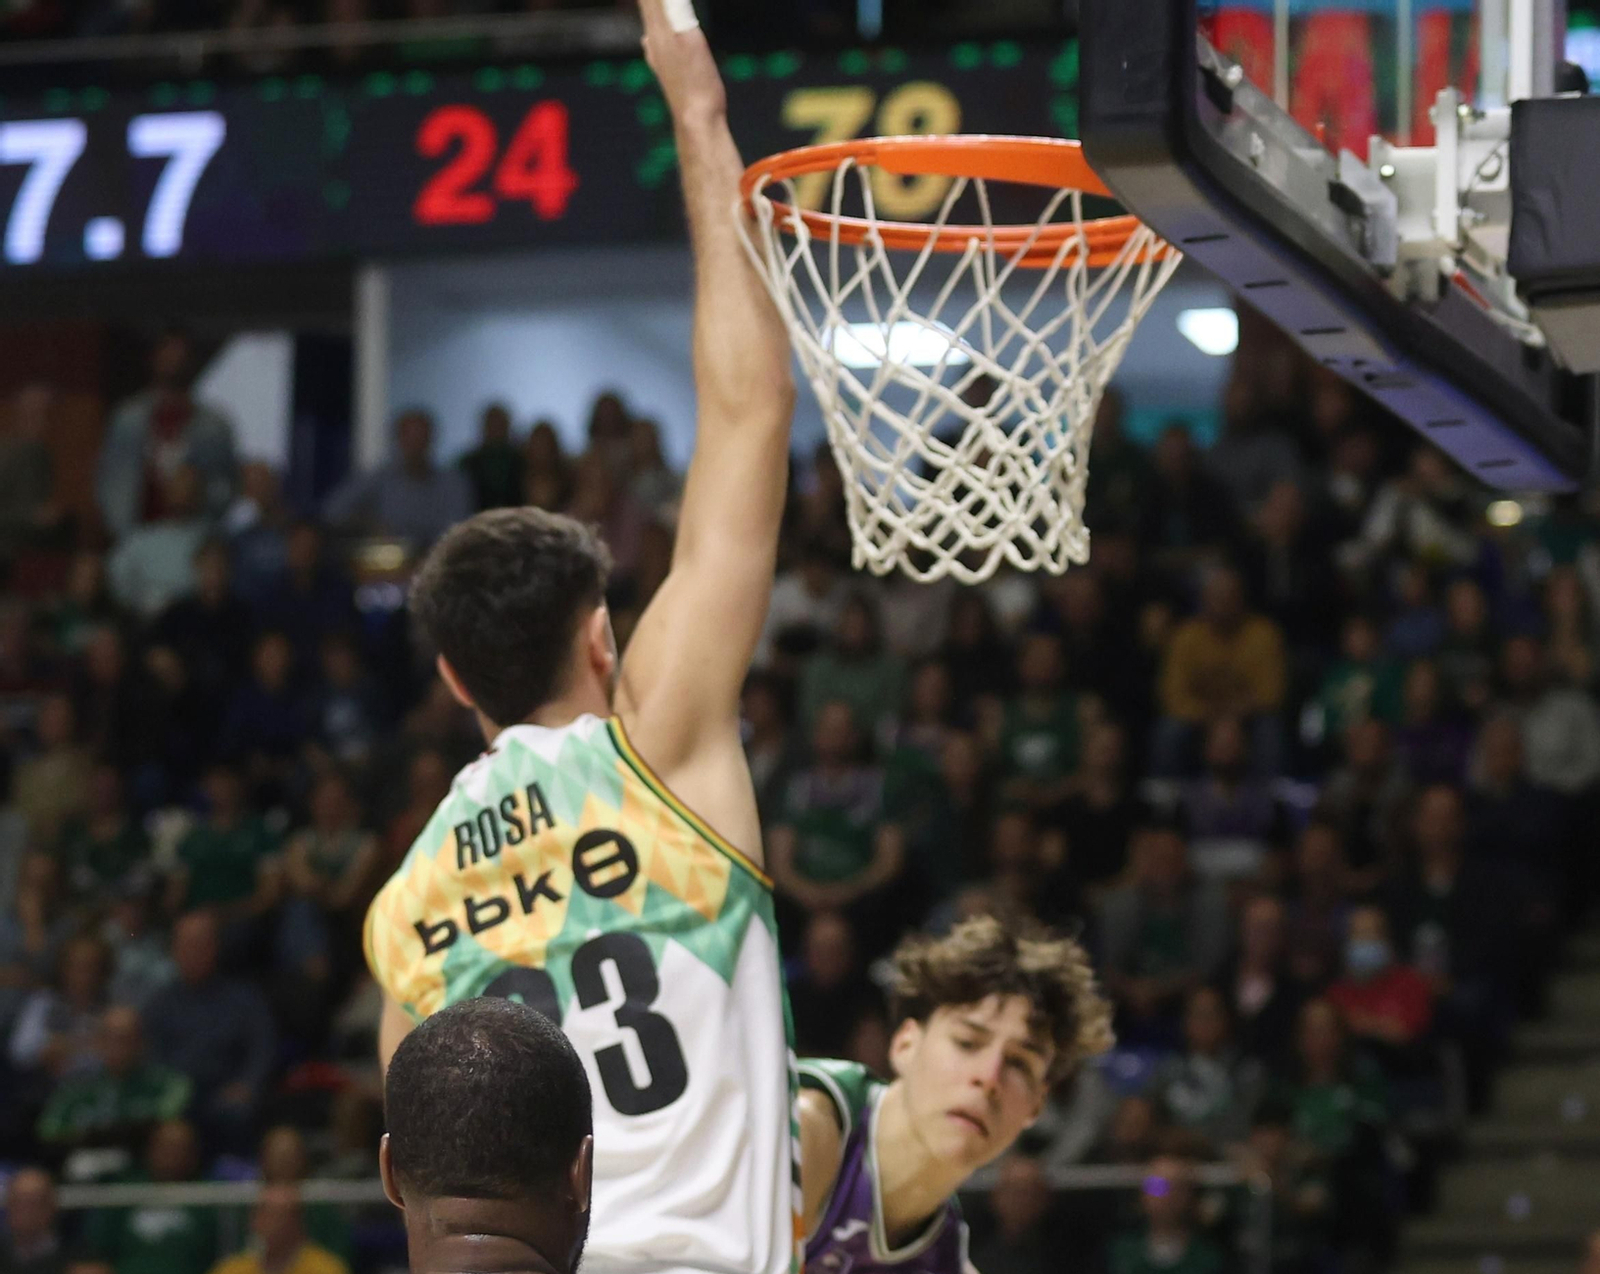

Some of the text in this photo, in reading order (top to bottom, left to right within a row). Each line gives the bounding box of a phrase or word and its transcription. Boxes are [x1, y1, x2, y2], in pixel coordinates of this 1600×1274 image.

[0, 111, 226, 264] 7.7
[414, 101, 578, 225] 24
[780, 82, 962, 220] 78
[453, 782, 556, 870] ROSA
[413, 867, 564, 957] bbk
[482, 930, 689, 1117] 3
